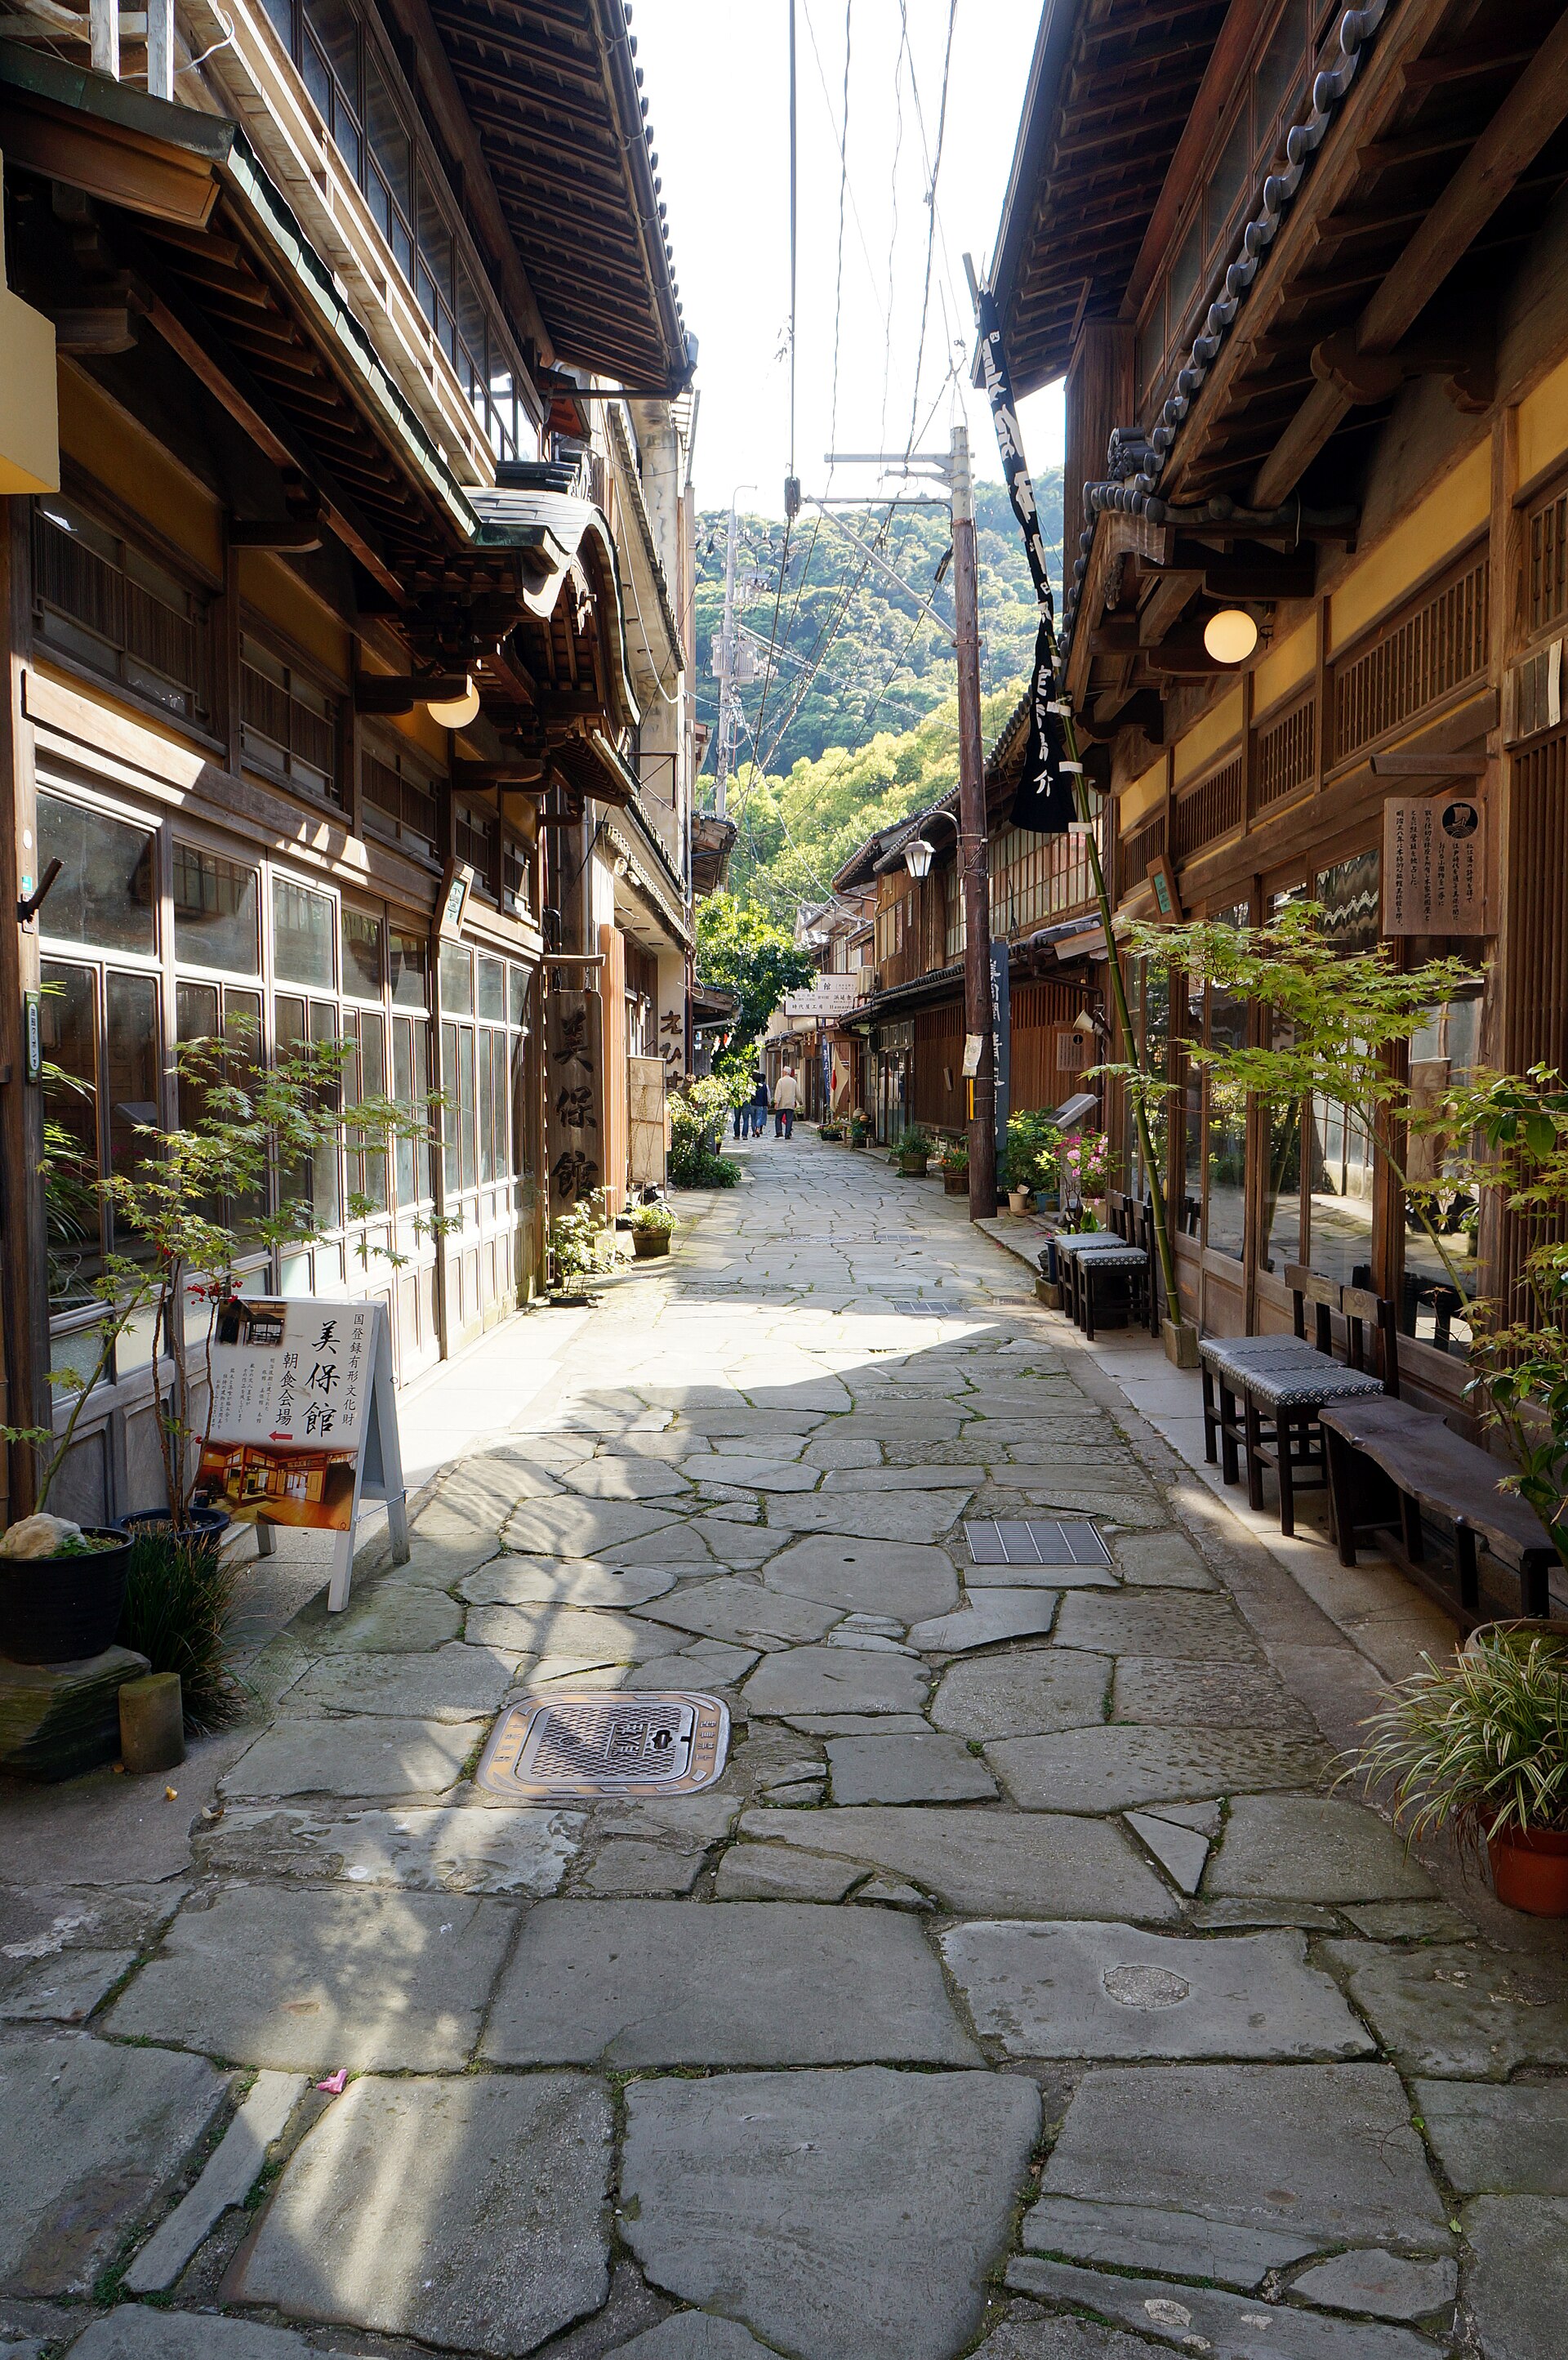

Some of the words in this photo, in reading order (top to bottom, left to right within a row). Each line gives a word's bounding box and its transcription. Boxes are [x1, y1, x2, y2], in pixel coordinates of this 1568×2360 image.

[552, 1011, 599, 1198] 美保館
[275, 1352, 299, 1426] 朝食会場
[301, 1320, 341, 1438] 美保館
[341, 1314, 365, 1426] 国登録有形文化財
[611, 1724, 644, 1757] 消火栓
[696, 1720, 716, 1761] 駐車禁止
